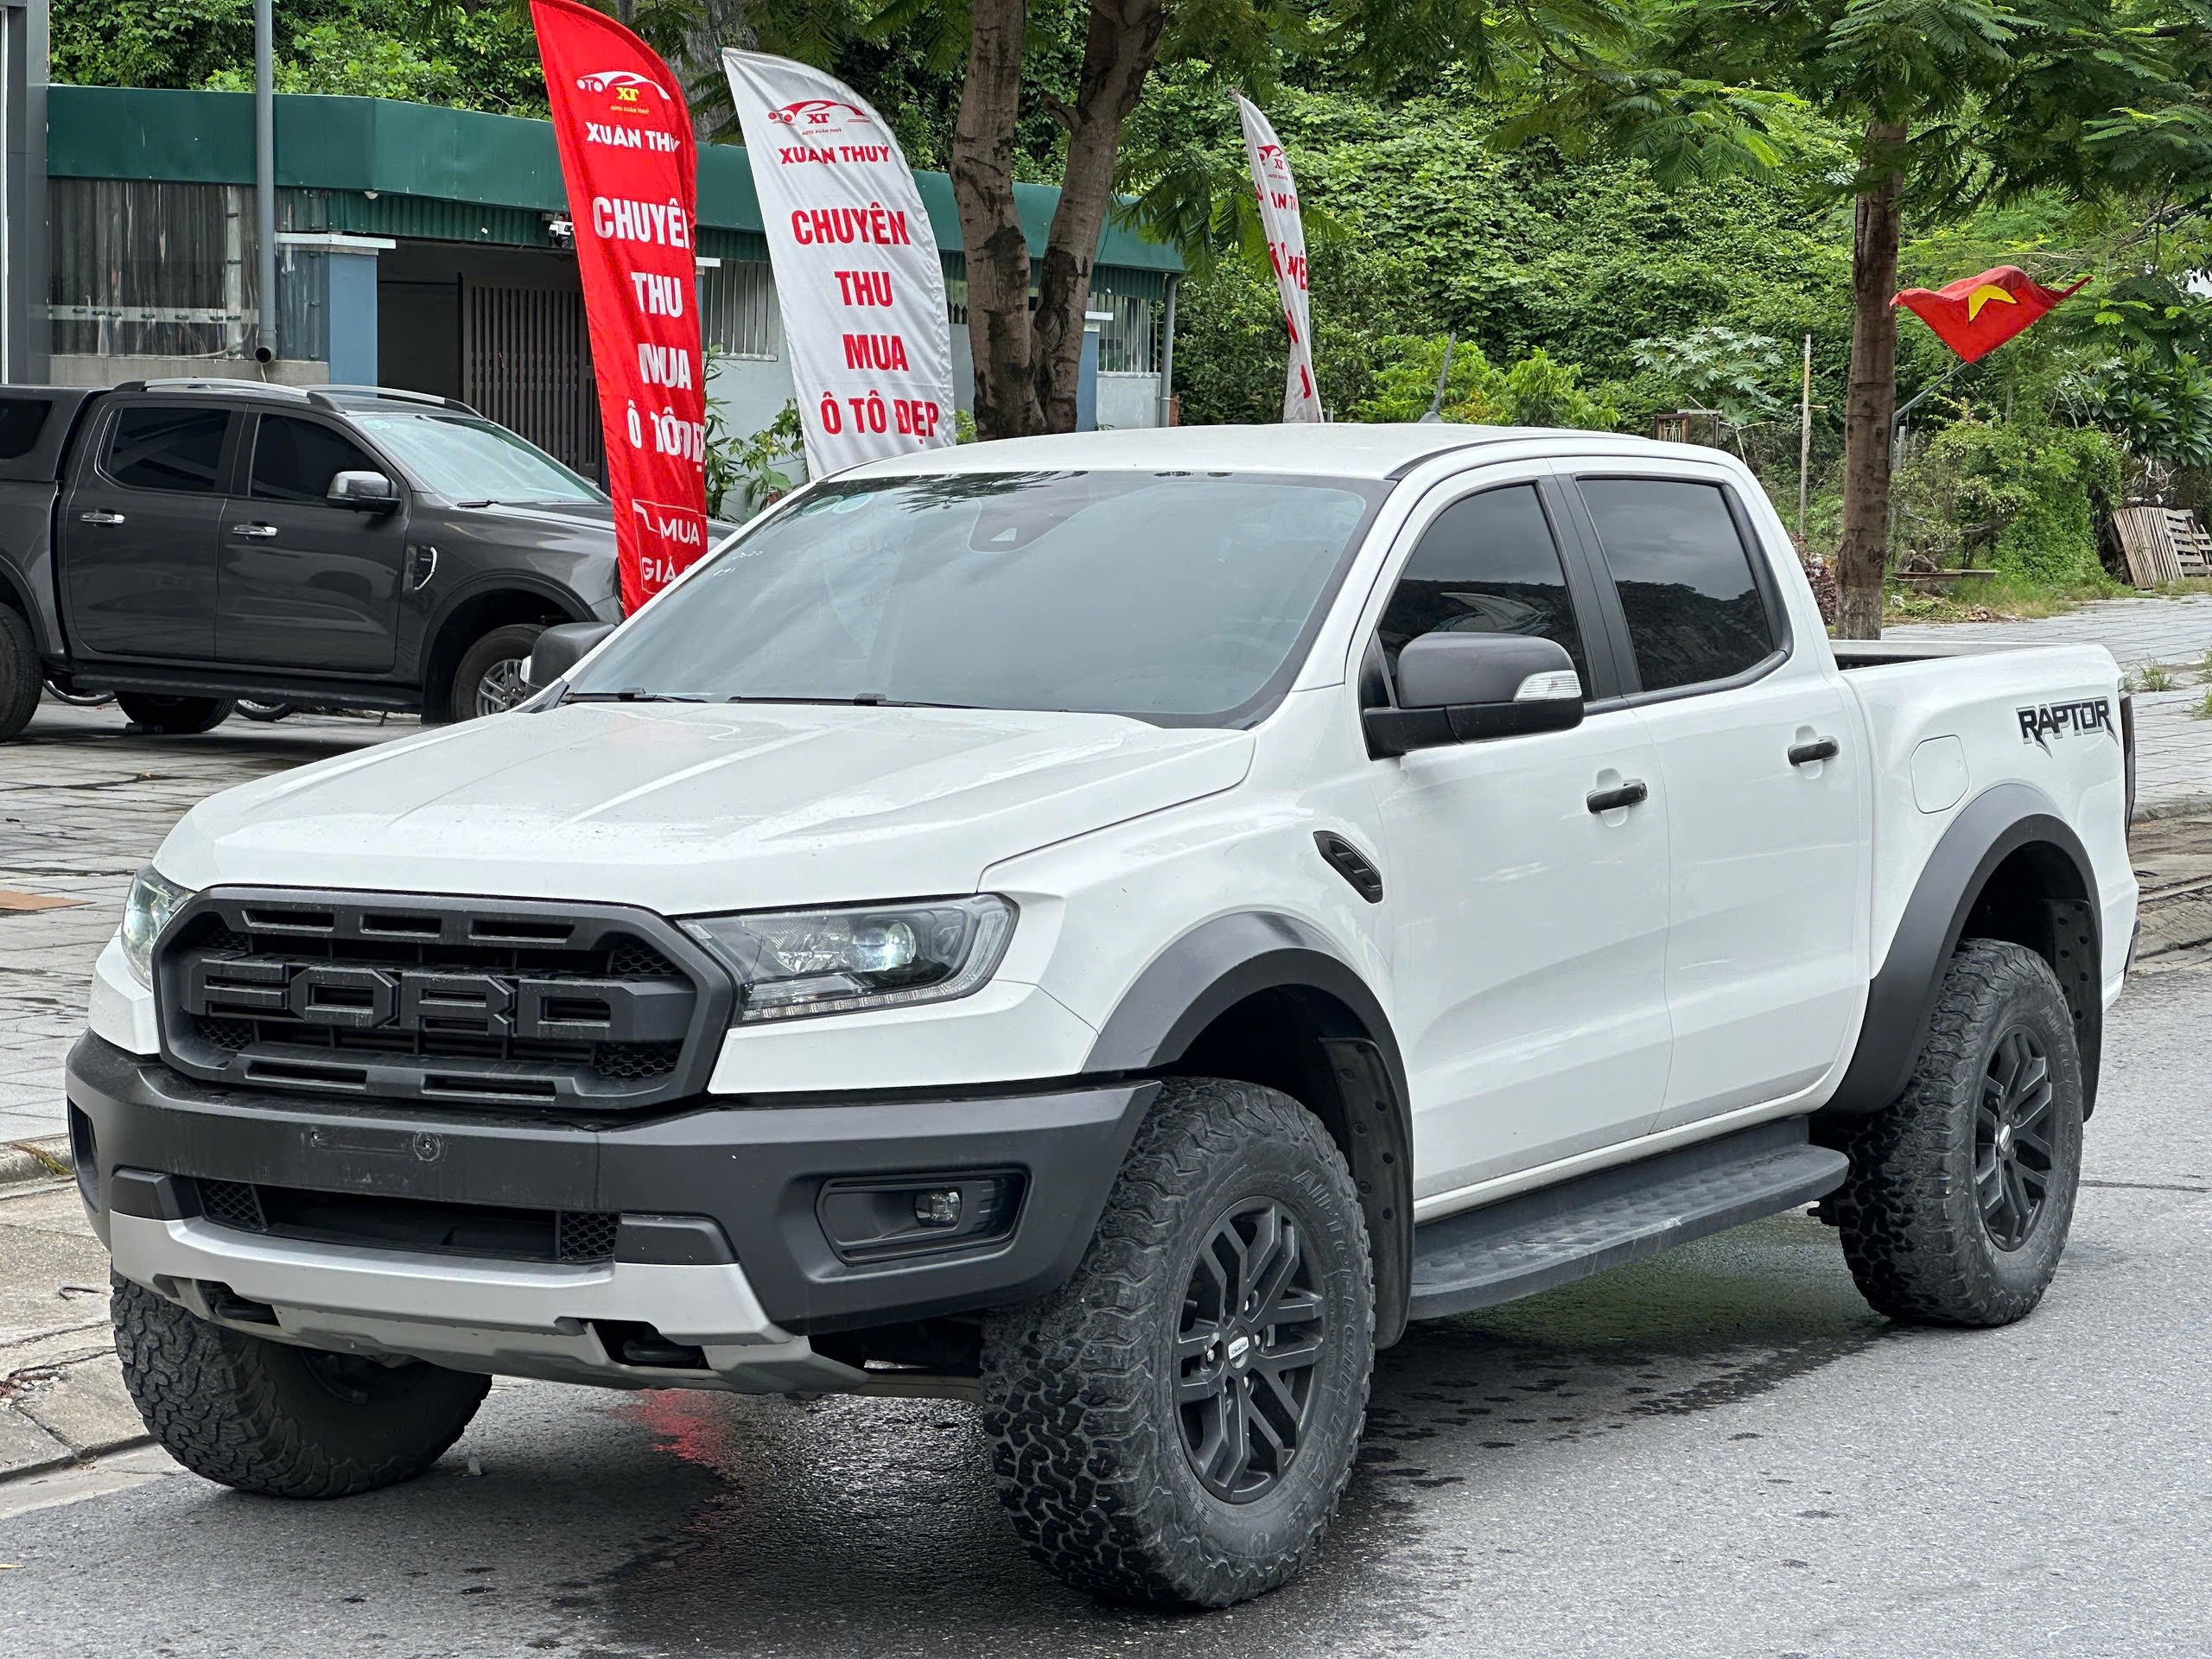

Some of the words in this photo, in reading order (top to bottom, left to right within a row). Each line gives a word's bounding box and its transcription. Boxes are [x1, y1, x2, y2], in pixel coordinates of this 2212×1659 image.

[616, 87, 639, 101] XT
[585, 122, 642, 149] XUÂN
[806, 113, 830, 124] XT
[791, 201, 911, 245] CHUYÊN
[631, 271, 683, 318] THU
[834, 270, 893, 308] THU
[842, 334, 910, 372] MUA
[626, 399, 642, 448] Ô
[650, 406, 681, 456] TÔ
[820, 391, 842, 435] Ô
[848, 389, 887, 434] TÔ
[893, 398, 939, 445] ĐẸP
[658, 516, 701, 547] MUA
[2016, 696, 2120, 760] RAPTOR
[188, 957, 638, 1039] FORD
